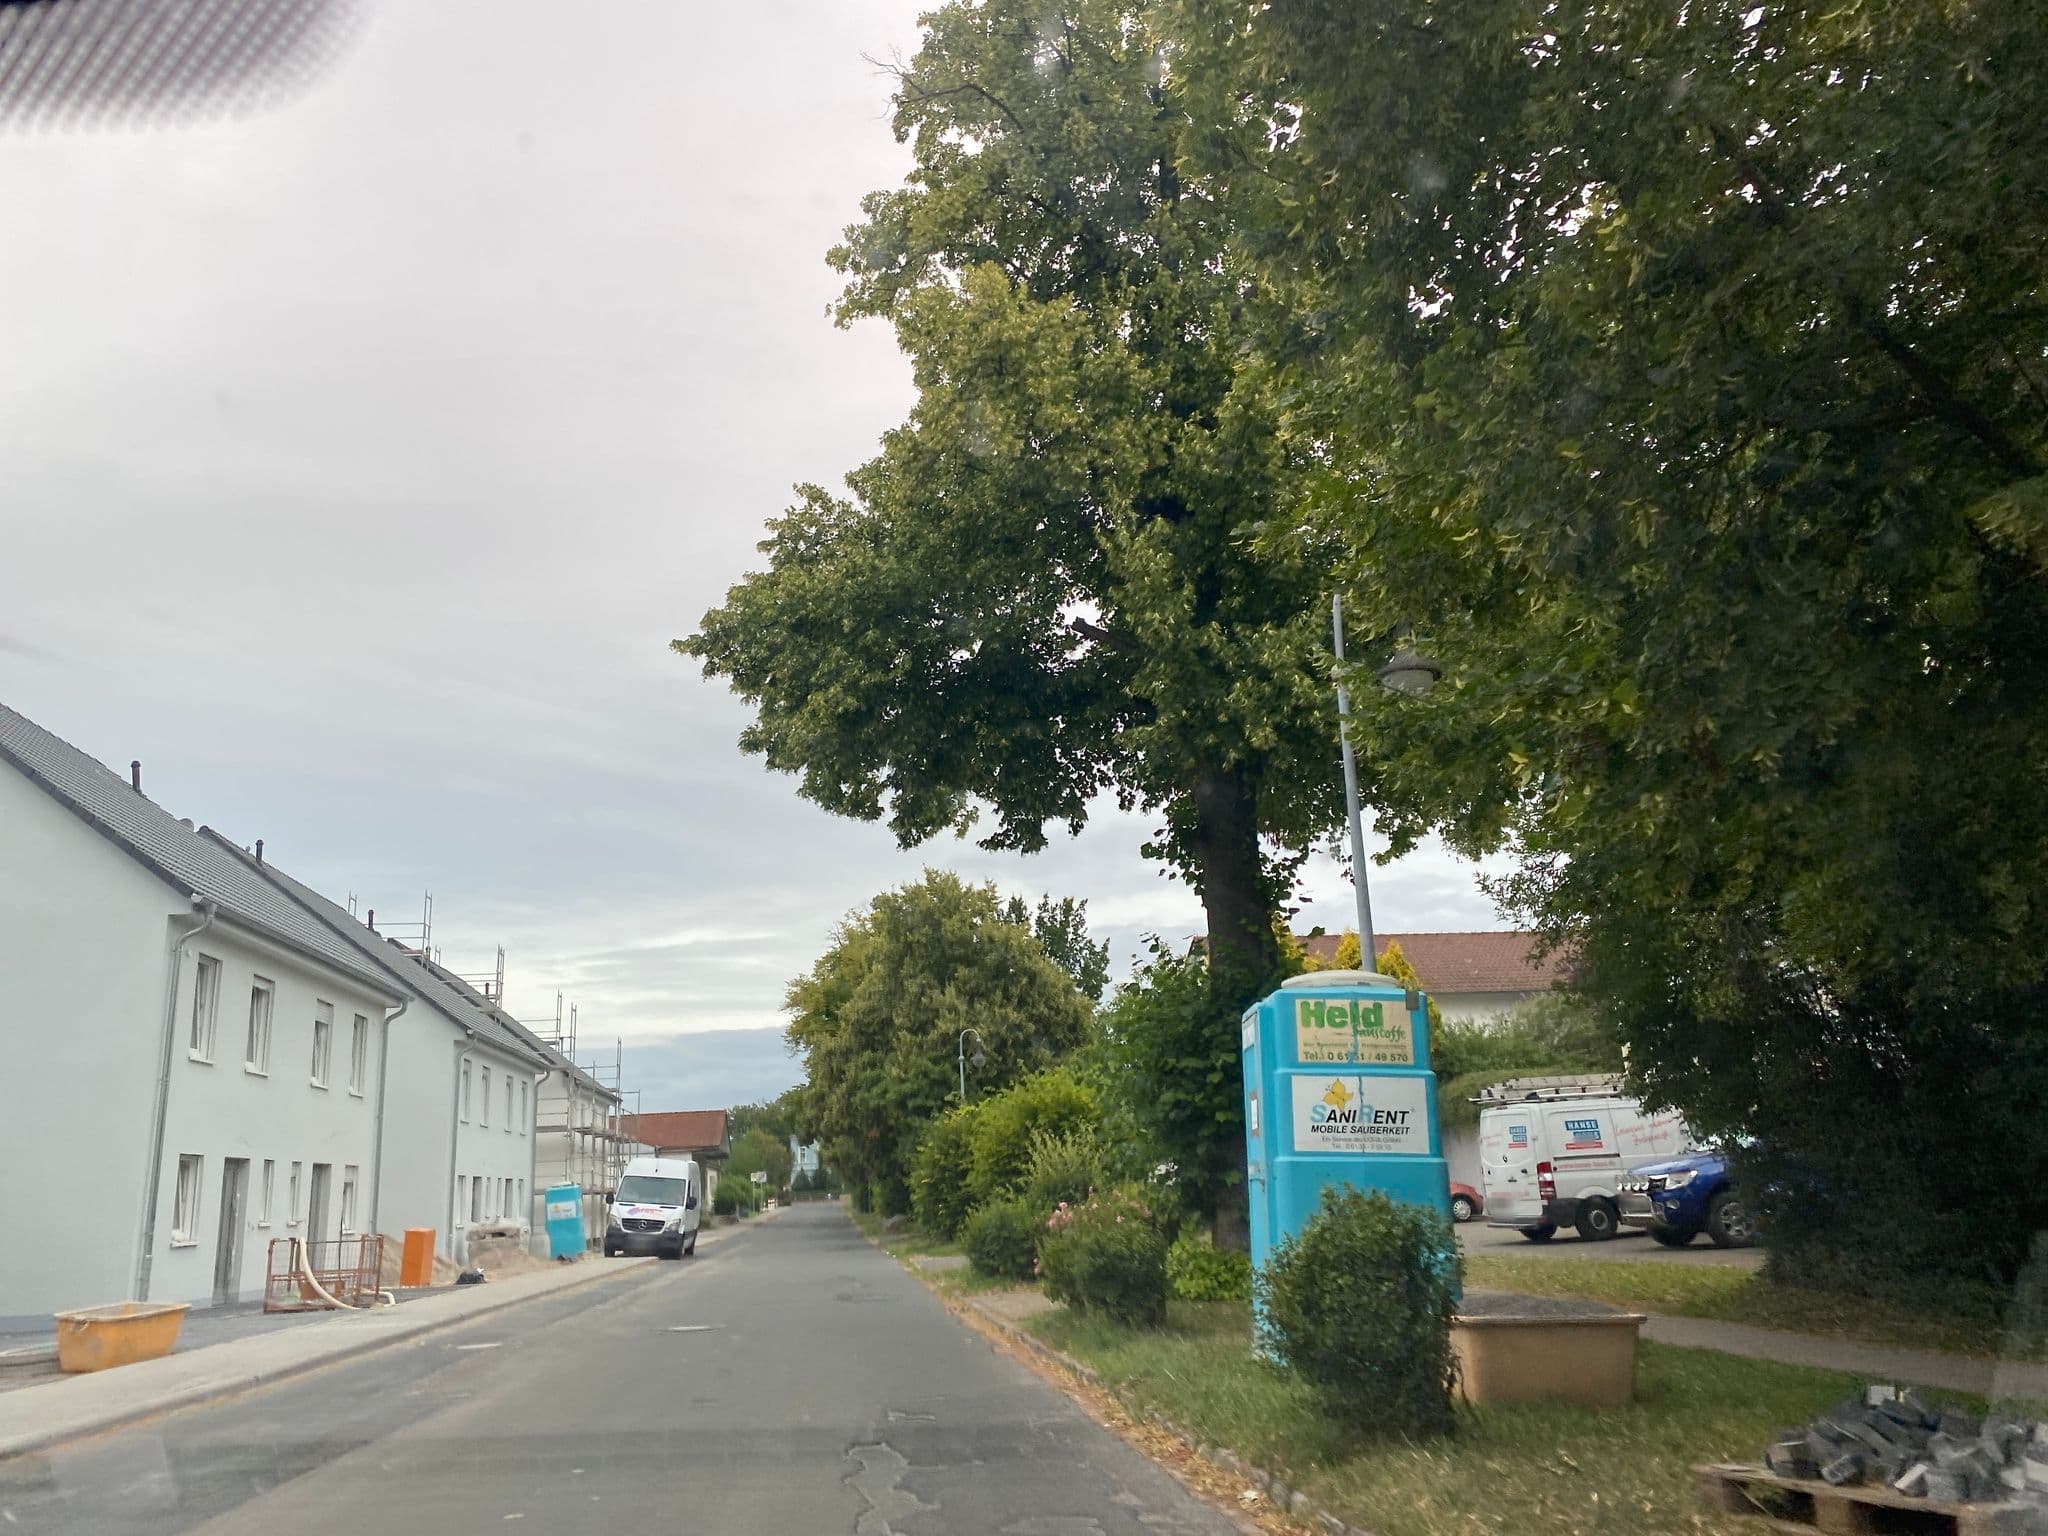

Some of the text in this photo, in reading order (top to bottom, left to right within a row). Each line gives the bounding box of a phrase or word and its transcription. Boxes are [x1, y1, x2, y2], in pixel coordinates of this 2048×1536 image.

[1300, 1000, 1384, 1029] Held
[1310, 1124, 1411, 1135] MOBILE SAUBERKEIT
